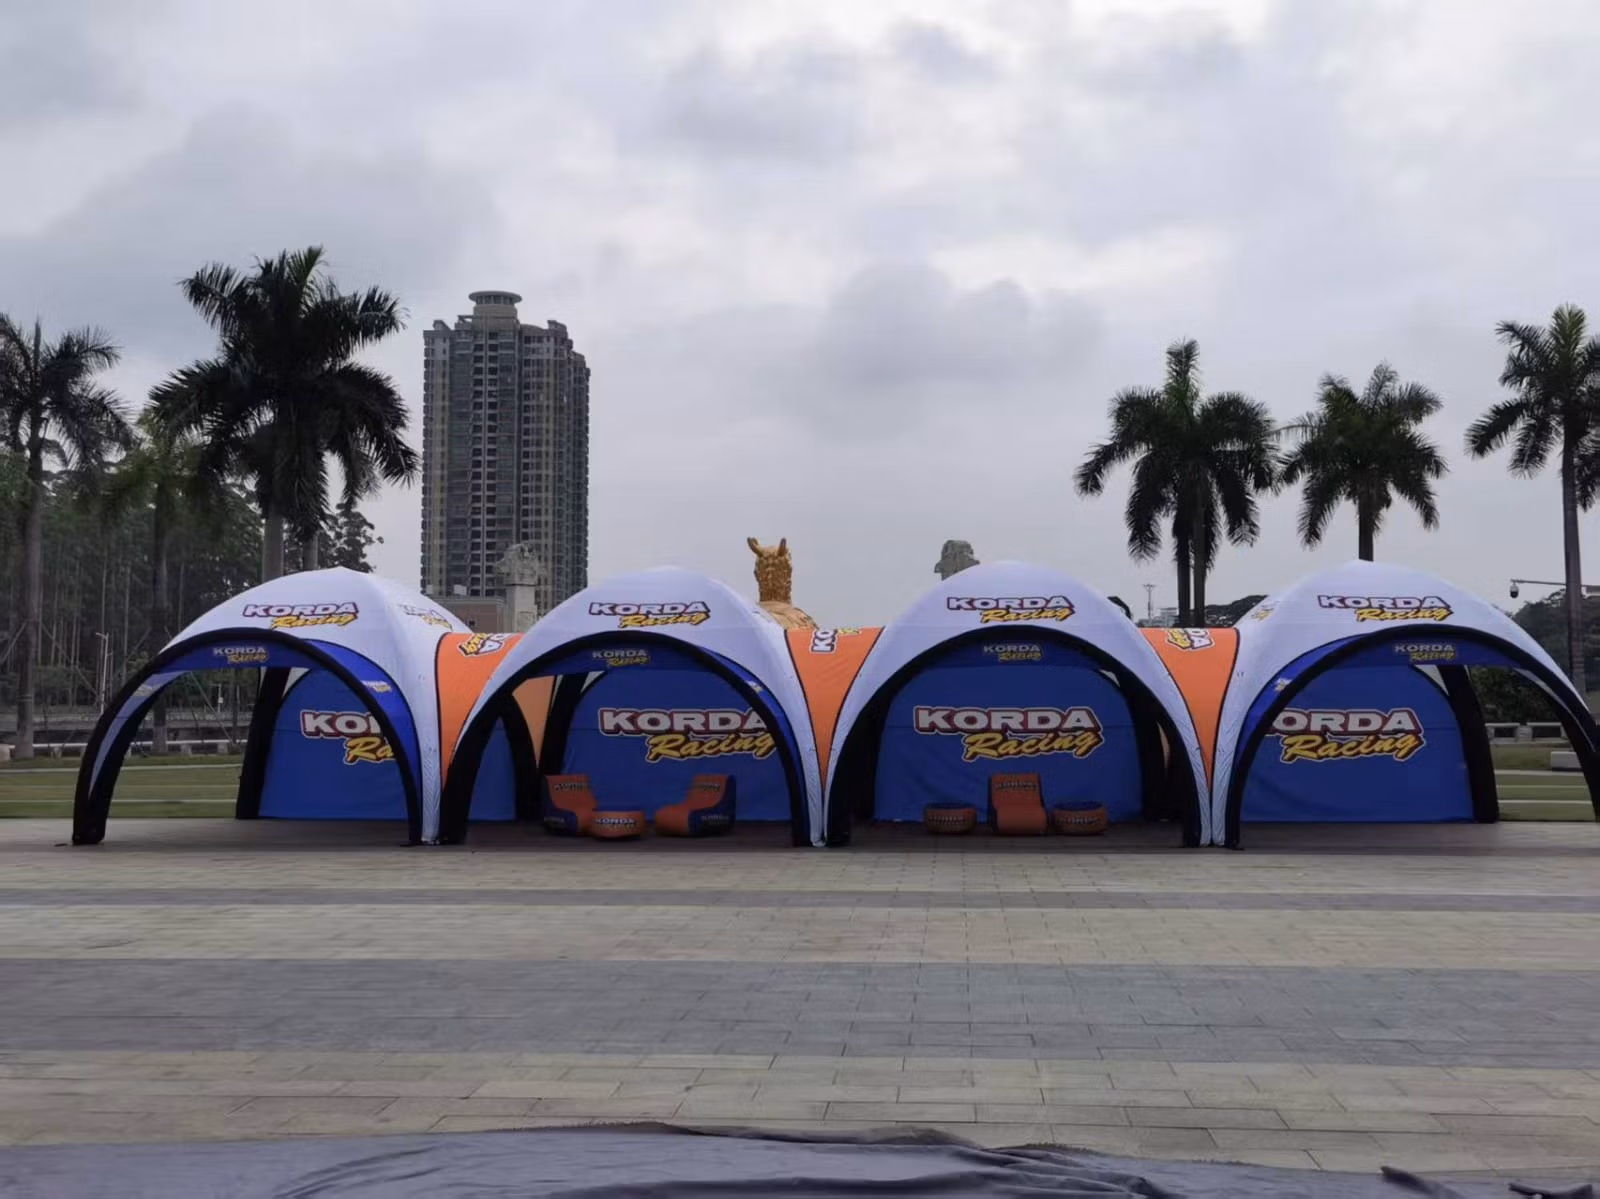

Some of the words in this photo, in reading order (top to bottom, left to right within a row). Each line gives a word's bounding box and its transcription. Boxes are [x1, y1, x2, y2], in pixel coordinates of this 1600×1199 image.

[243, 602, 359, 617] KORDA
[589, 601, 711, 616] KORDA
[947, 595, 1074, 610] KORDA
[1318, 595, 1452, 609] KORDA
[270, 614, 358, 630] Racing
[618, 612, 711, 628] Racing
[980, 608, 1075, 623] Racing
[1355, 608, 1454, 622] Racing
[213, 646, 266, 656] KORDA
[592, 649, 647, 658] KORDA
[983, 644, 1041, 653] KORDA
[1394, 644, 1455, 653] KORDA
[599, 708, 768, 735] KORDA
[914, 707, 1102, 734] KORDA
[1271, 708, 1422, 735] ORDA
[647, 732, 777, 762] Racing
[962, 731, 1104, 761] Racing
[1281, 734, 1426, 763] Racing
